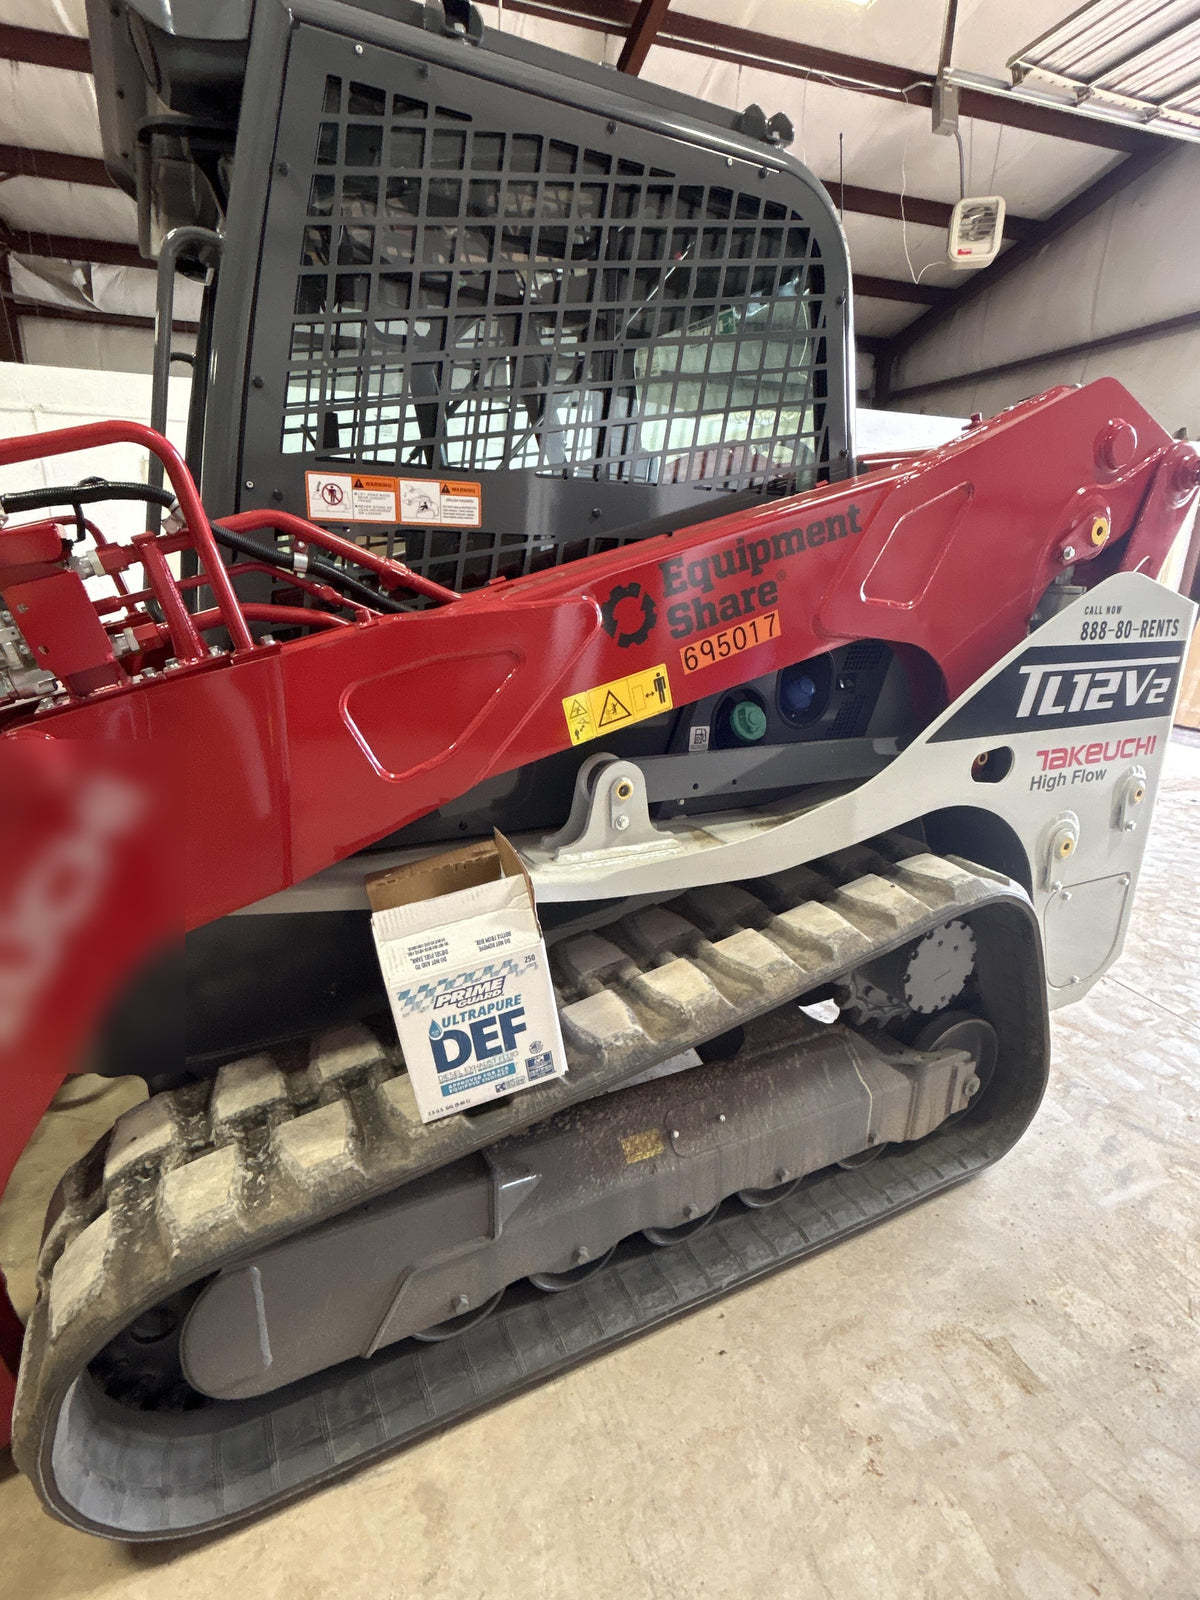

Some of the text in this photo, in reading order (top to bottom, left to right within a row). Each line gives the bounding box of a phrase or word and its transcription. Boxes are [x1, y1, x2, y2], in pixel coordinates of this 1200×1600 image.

[658, 503, 862, 597] Equipment
[1084, 605, 1122, 615] CALL NOW
[683, 613, 777, 671] 695017
[1080, 618, 1180, 641] 888-80-RENTS
[1016, 656, 1181, 718] TL12V2
[1036, 735, 1157, 771] TAKEUCHI
[1029, 768, 1107, 792] High Flow
[524, 954, 536, 963] 250
[434, 976, 506, 1009] PRIME
[441, 994, 522, 1028] ULTRAPURE
[429, 1007, 527, 1073] DEF
[438, 1070, 464, 1081] DIESEL
[464, 1059, 496, 1073] EXHAUST
[495, 1050, 519, 1064] FLUID
[448, 1075, 482, 1089] APPROVED
[483, 1070, 497, 1078] FOR
[449, 1071, 509, 1093] EQUIPPED ENGINES
